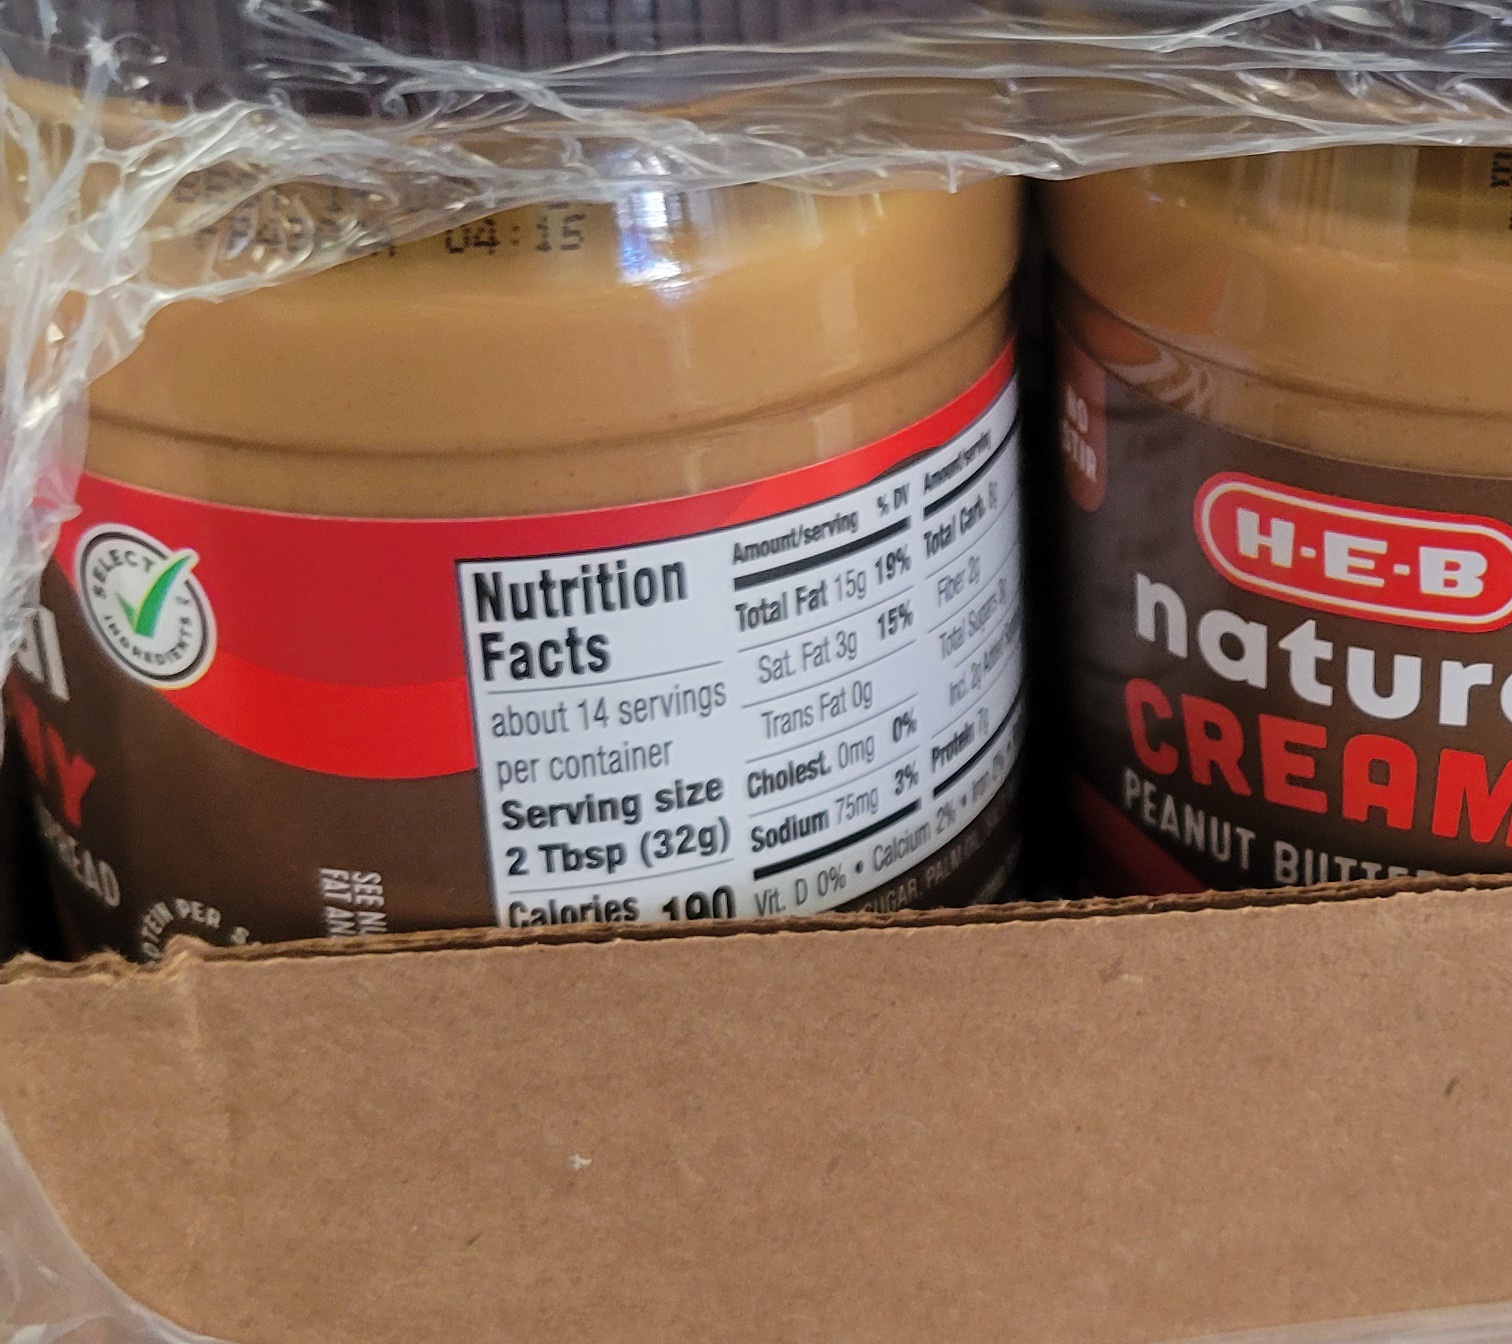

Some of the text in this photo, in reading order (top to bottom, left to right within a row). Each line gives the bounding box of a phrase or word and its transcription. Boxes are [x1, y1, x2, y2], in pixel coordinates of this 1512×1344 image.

[733, 511, 860, 565] Amount/serving
[924, 514, 957, 560] Total
[93, 548, 155, 600] SELECT
[474, 559, 689, 623] Nutrition
[735, 544, 912, 633] Total Fat 15g 19%
[480, 626, 611, 682] Facts
[758, 599, 915, 684] Sat. Fat 3g 15%
[491, 681, 728, 738] about 14 servings
[761, 679, 873, 740] Trans Fat 0g
[497, 740, 674, 793] per container
[746, 707, 918, 799] Cholest. 0mg 0%
[501, 776, 725, 831] Serving size
[751, 760, 920, 853] Sodium 75mg 3%
[1121, 765, 1257, 871] PEANUT
[505, 815, 732, 877] 2 Tbsp (32g)
[754, 887, 787, 918] Vit.
[794, 877, 808, 906] D
[817, 863, 847, 898] 0%
[872, 821, 932, 872] Calcium
[174, 897, 222, 929] PER
[319, 867, 357, 939] FAT AN
[350, 870, 386, 907] SEE
[508, 894, 640, 929] Calories
